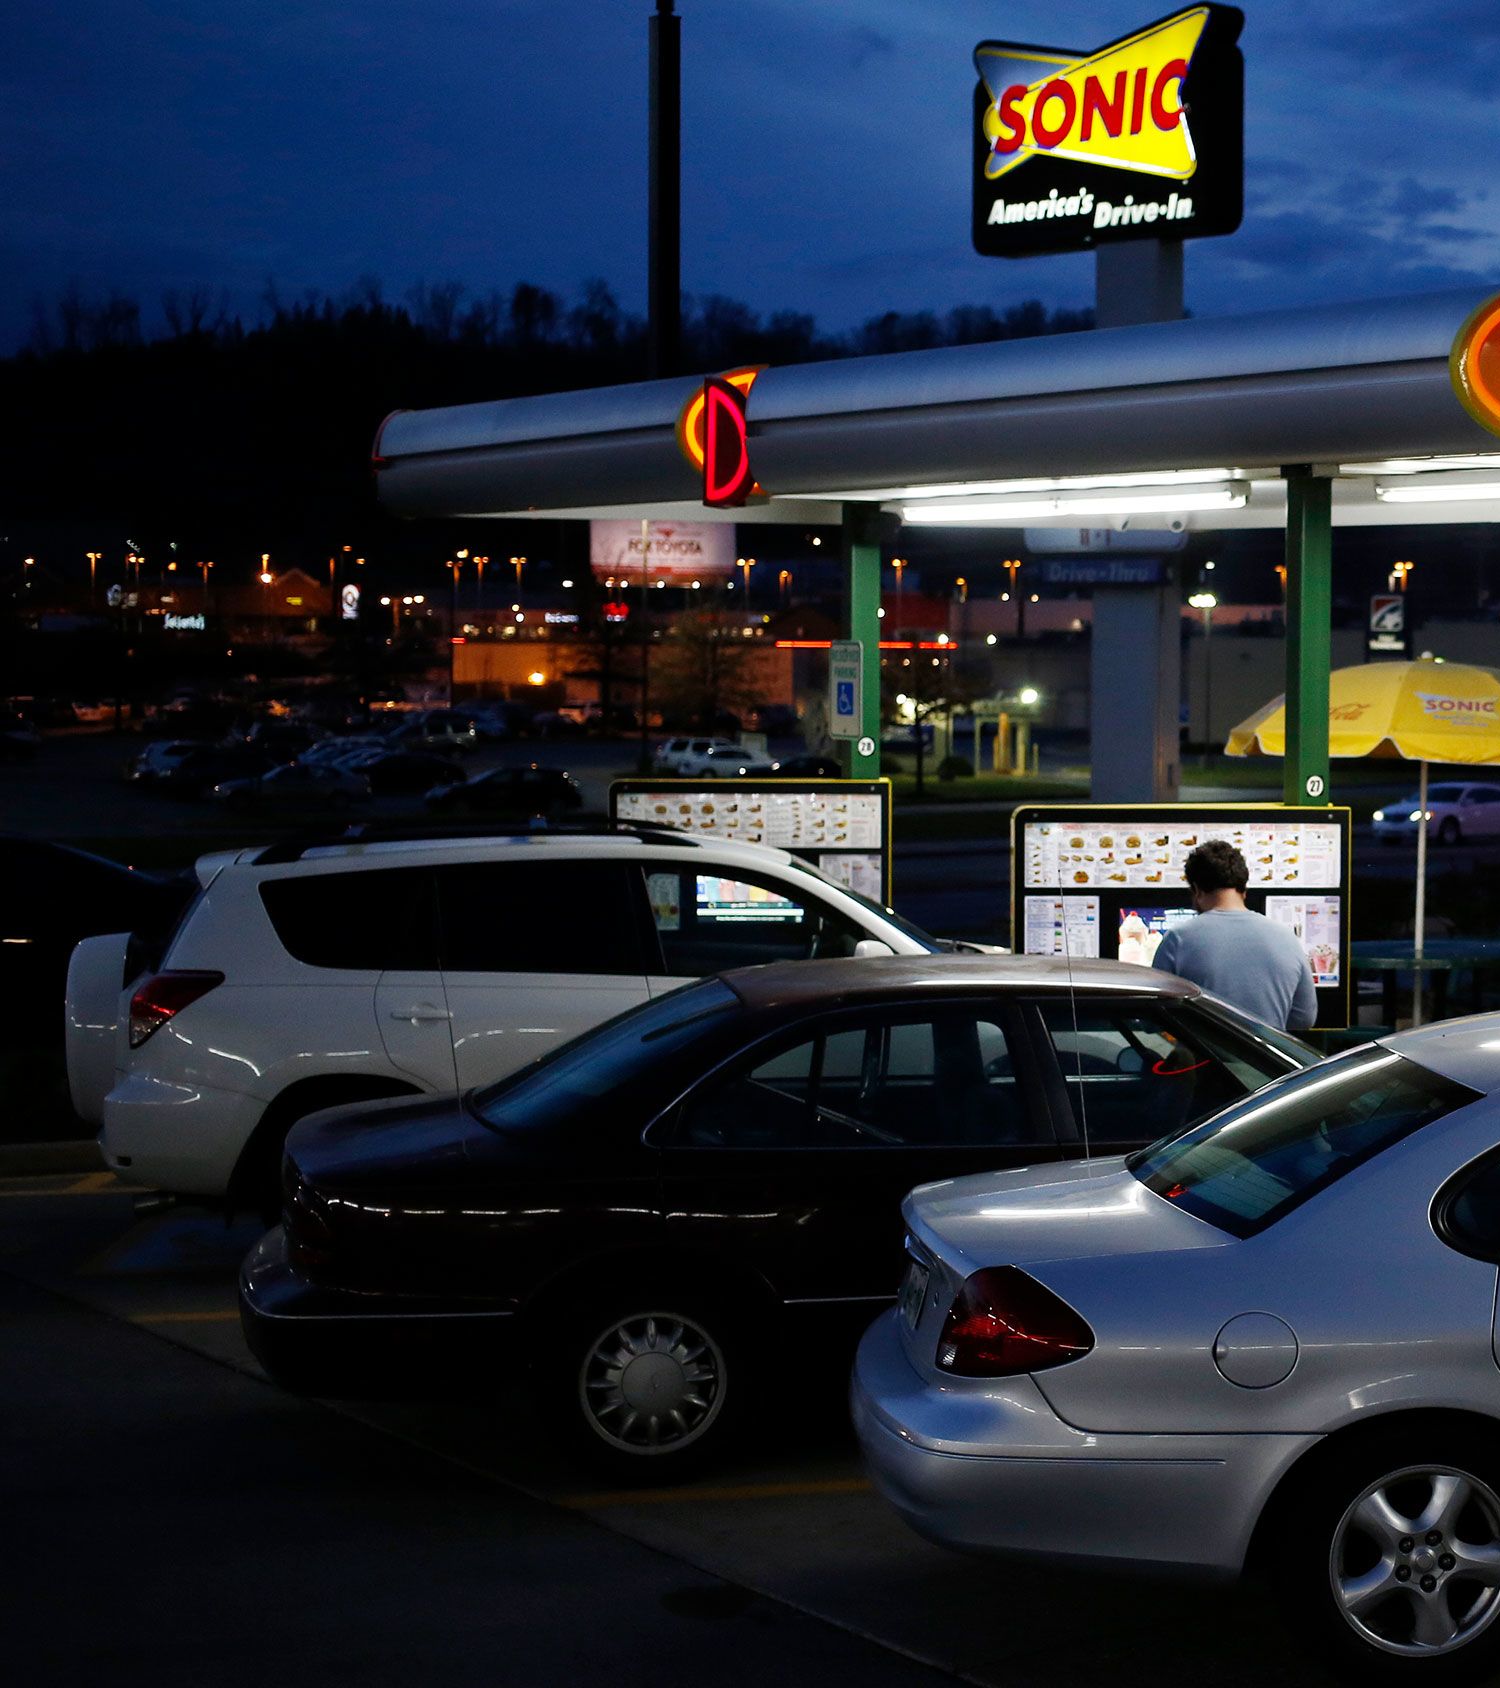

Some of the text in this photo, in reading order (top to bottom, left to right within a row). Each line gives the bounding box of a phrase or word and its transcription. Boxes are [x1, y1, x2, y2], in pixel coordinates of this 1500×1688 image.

[994, 59, 1188, 155] SONIC
[987, 188, 1094, 225] America's
[655, 539, 703, 555] TOYOTA
[1048, 560, 1150, 583] Drive-Thru
[1425, 699, 1496, 713] SONIC
[861, 742, 872, 752] 28
[1309, 780, 1322, 796] 27
